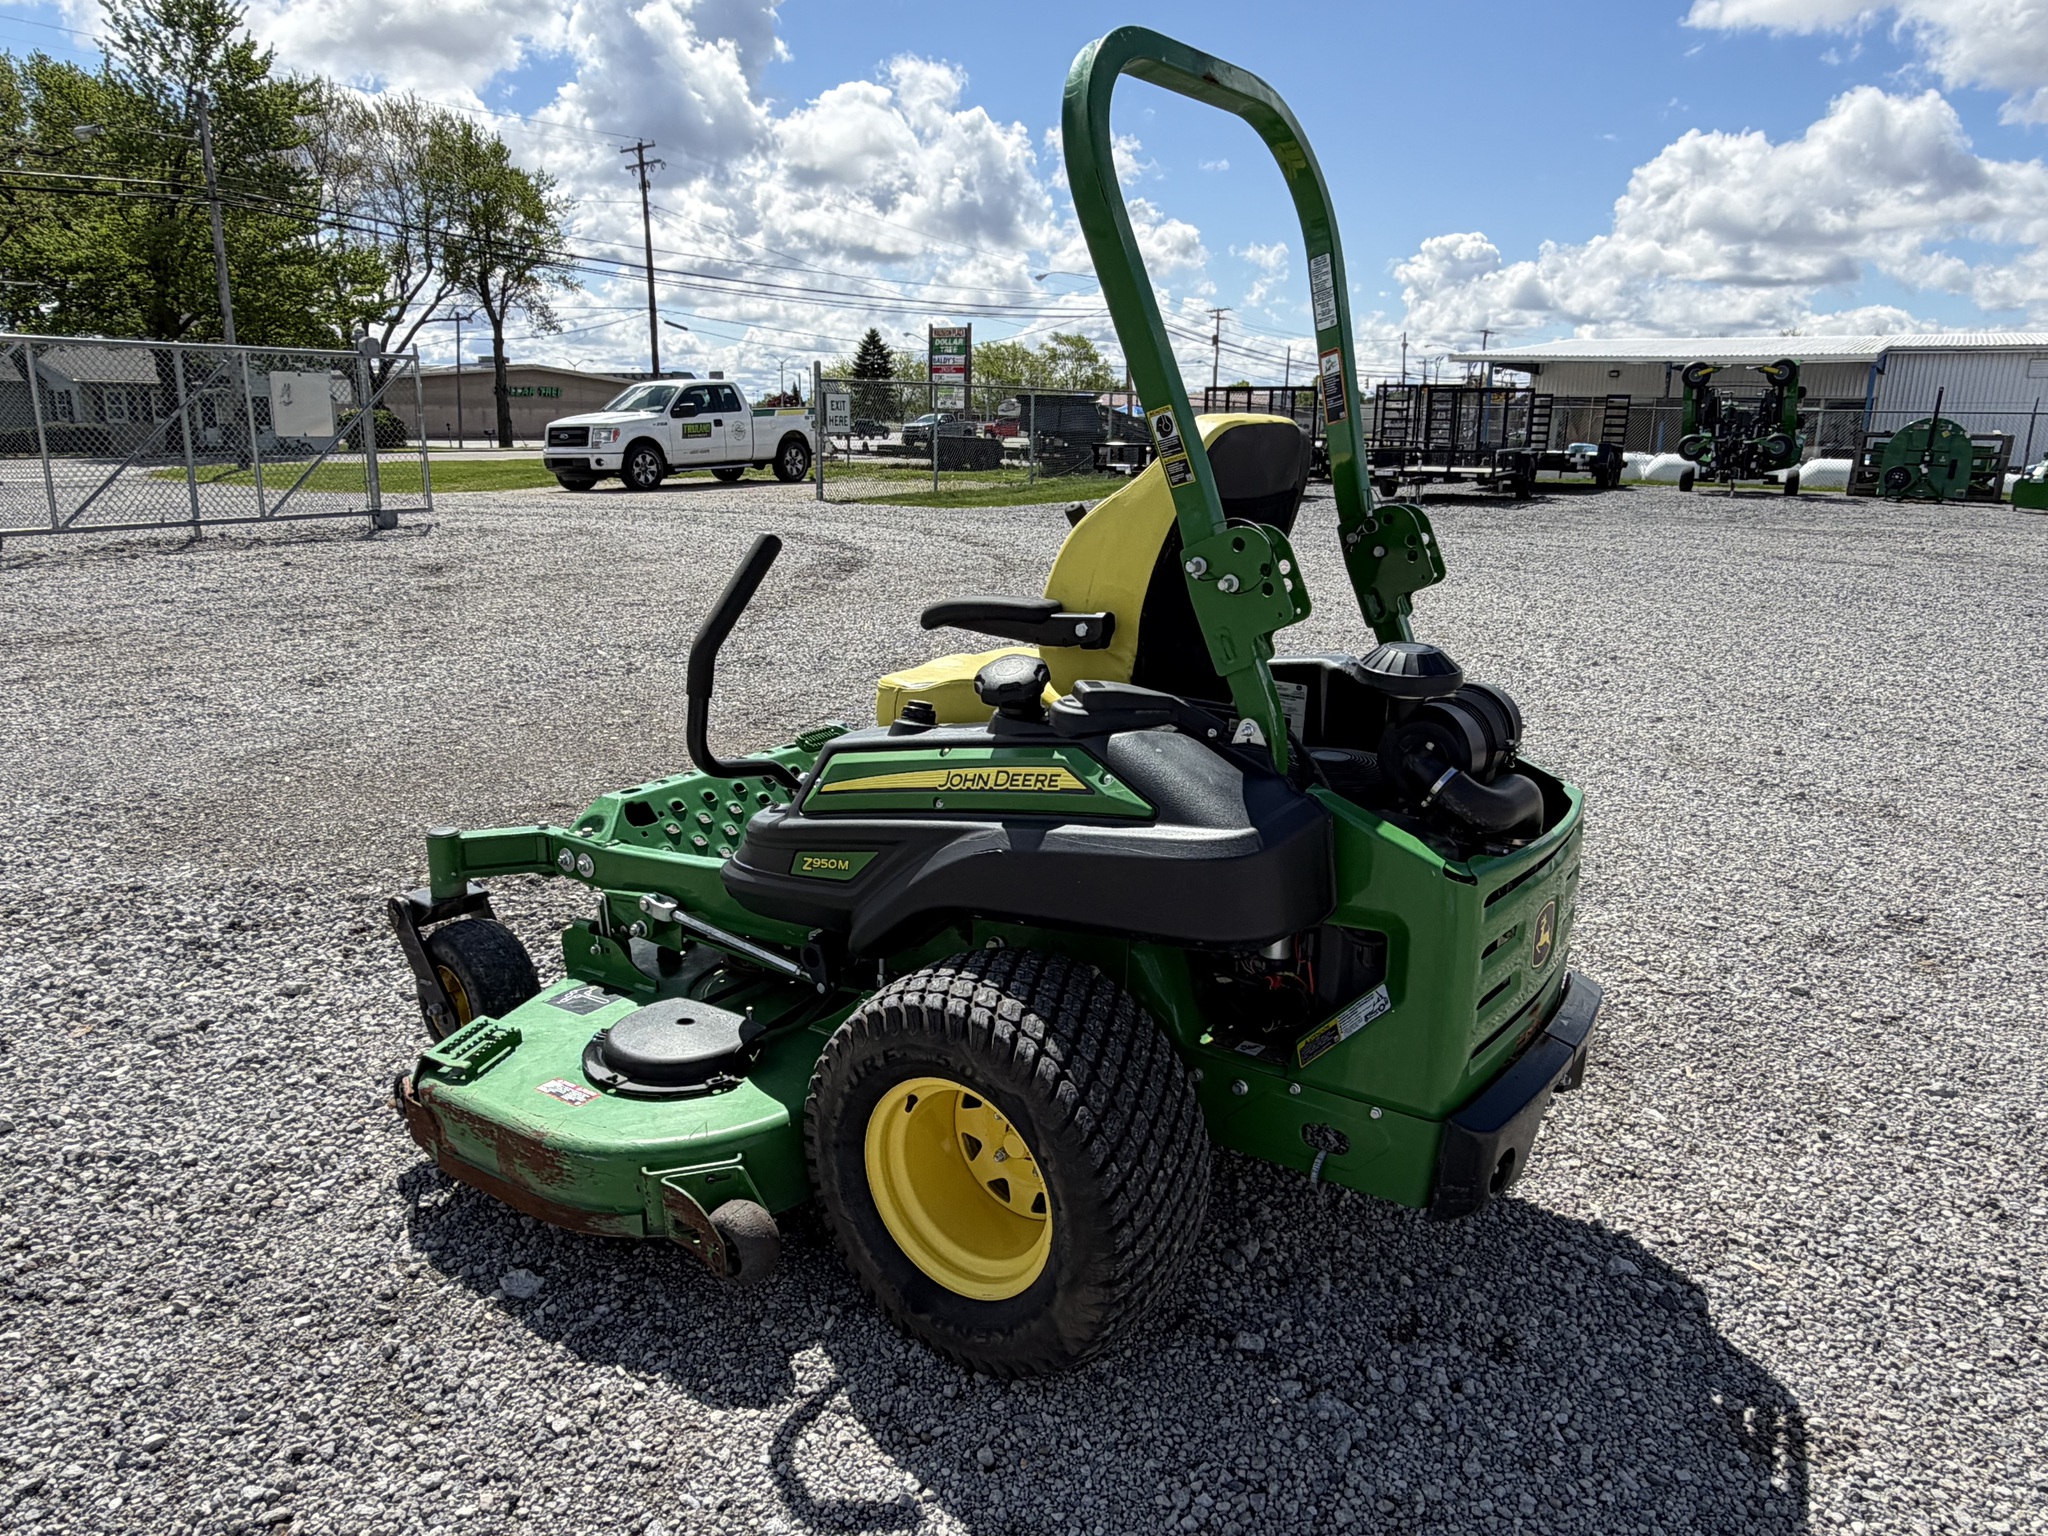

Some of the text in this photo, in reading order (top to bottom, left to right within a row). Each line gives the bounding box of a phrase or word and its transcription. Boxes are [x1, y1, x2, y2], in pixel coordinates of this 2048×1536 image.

[935, 338, 964, 346] DOLLAR
[940, 346, 958, 354] TREE
[539, 386, 563, 397] TREE
[830, 400, 846, 412] EXIT
[828, 415, 849, 427] HERE
[937, 769, 1062, 788] JOHN DEERE
[802, 857, 849, 871] Z950M
